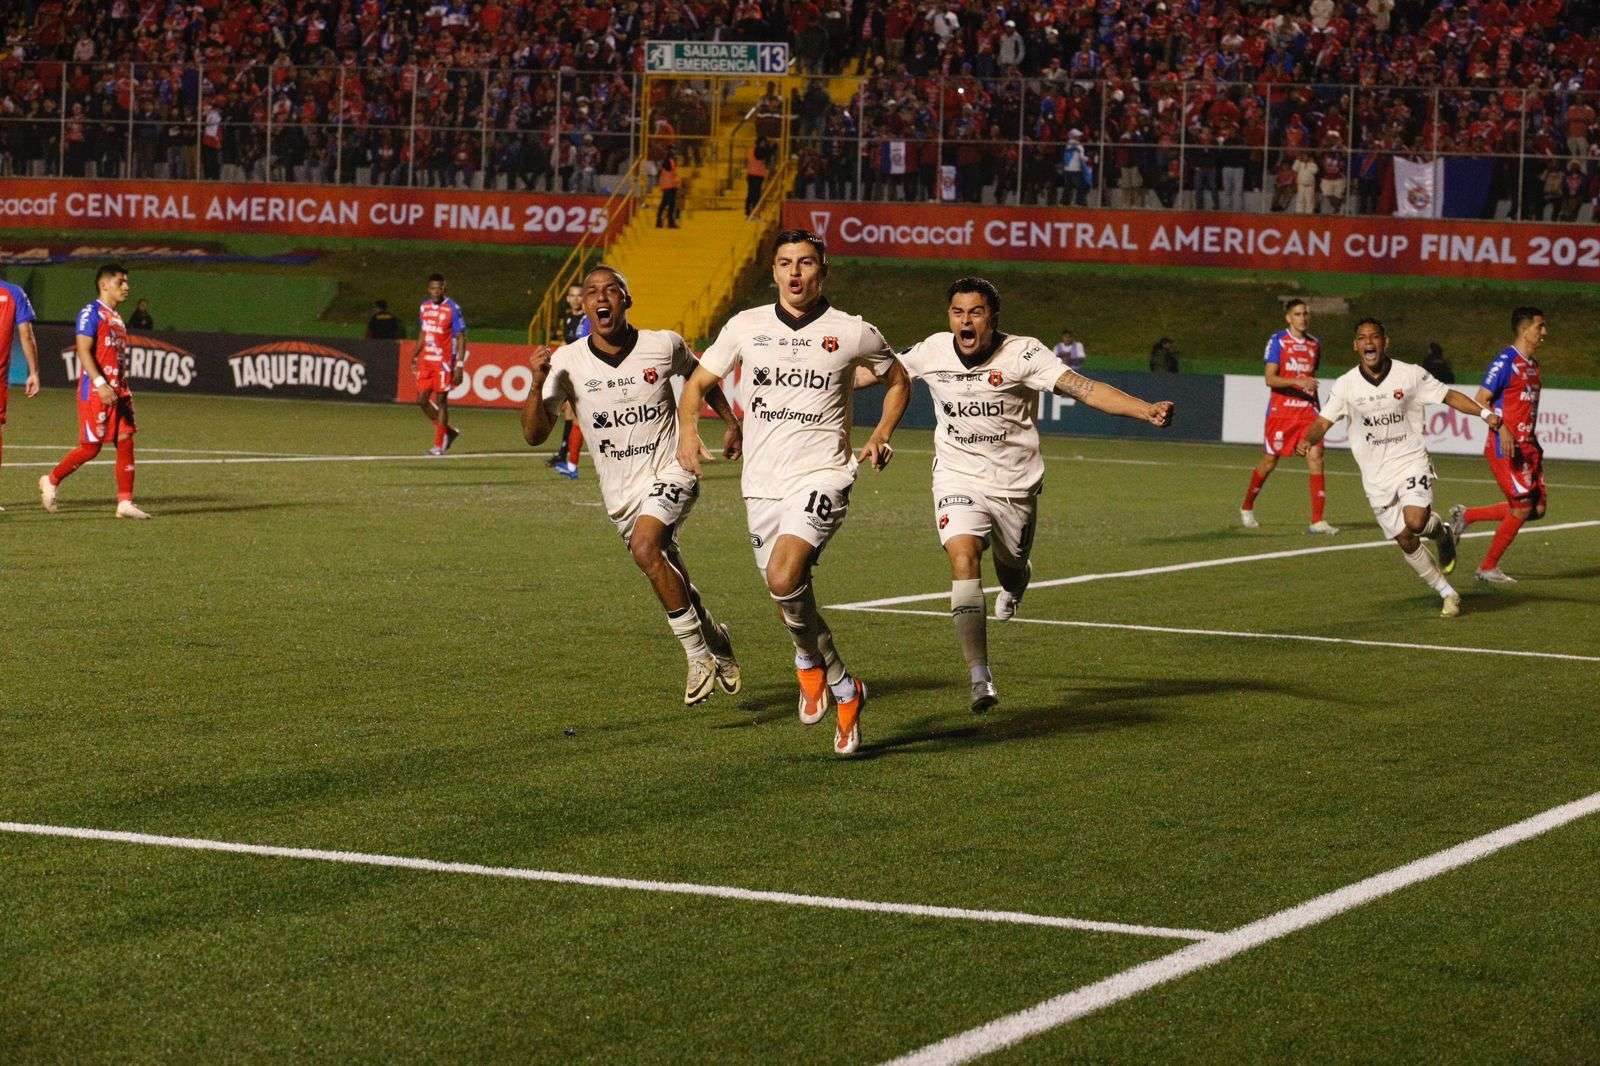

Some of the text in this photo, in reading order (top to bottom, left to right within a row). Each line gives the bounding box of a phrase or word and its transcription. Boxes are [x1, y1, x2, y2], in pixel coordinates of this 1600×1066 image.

[684, 45, 748, 58] SALIDA DE
[761, 47, 784, 71] 13
[676, 58, 757, 71] EMERGENCIA
[65, 192, 195, 219] CENTRAL
[205, 196, 358, 224] AMERICAN
[369, 203, 424, 225] CUP
[434, 204, 515, 230] FINAL
[523, 206, 609, 233] 2025
[840, 217, 974, 245] Concacaf
[984, 220, 1137, 250] CENTRAL
[1150, 225, 1330, 256] AMERICAN
[1344, 234, 1409, 258] CUP
[1420, 234, 1517, 264] FINAL
[791, 338, 812, 347] BAC
[228, 354, 365, 395] TAQUERITOS
[618, 377, 636, 386] BAC
[775, 367, 832, 391] kölbi
[613, 401, 662, 427] kölbi
[760, 407, 824, 424] medismart
[957, 400, 1004, 417] kölbi
[1373, 411, 1405, 427] kölbi
[955, 430, 1007, 444] medismart
[1535, 427, 1584, 445] rabia
[610, 441, 659, 461] medisma
[1405, 474, 1429, 490] 34
[648, 482, 683, 504] 33
[804, 490, 832, 521] 18
